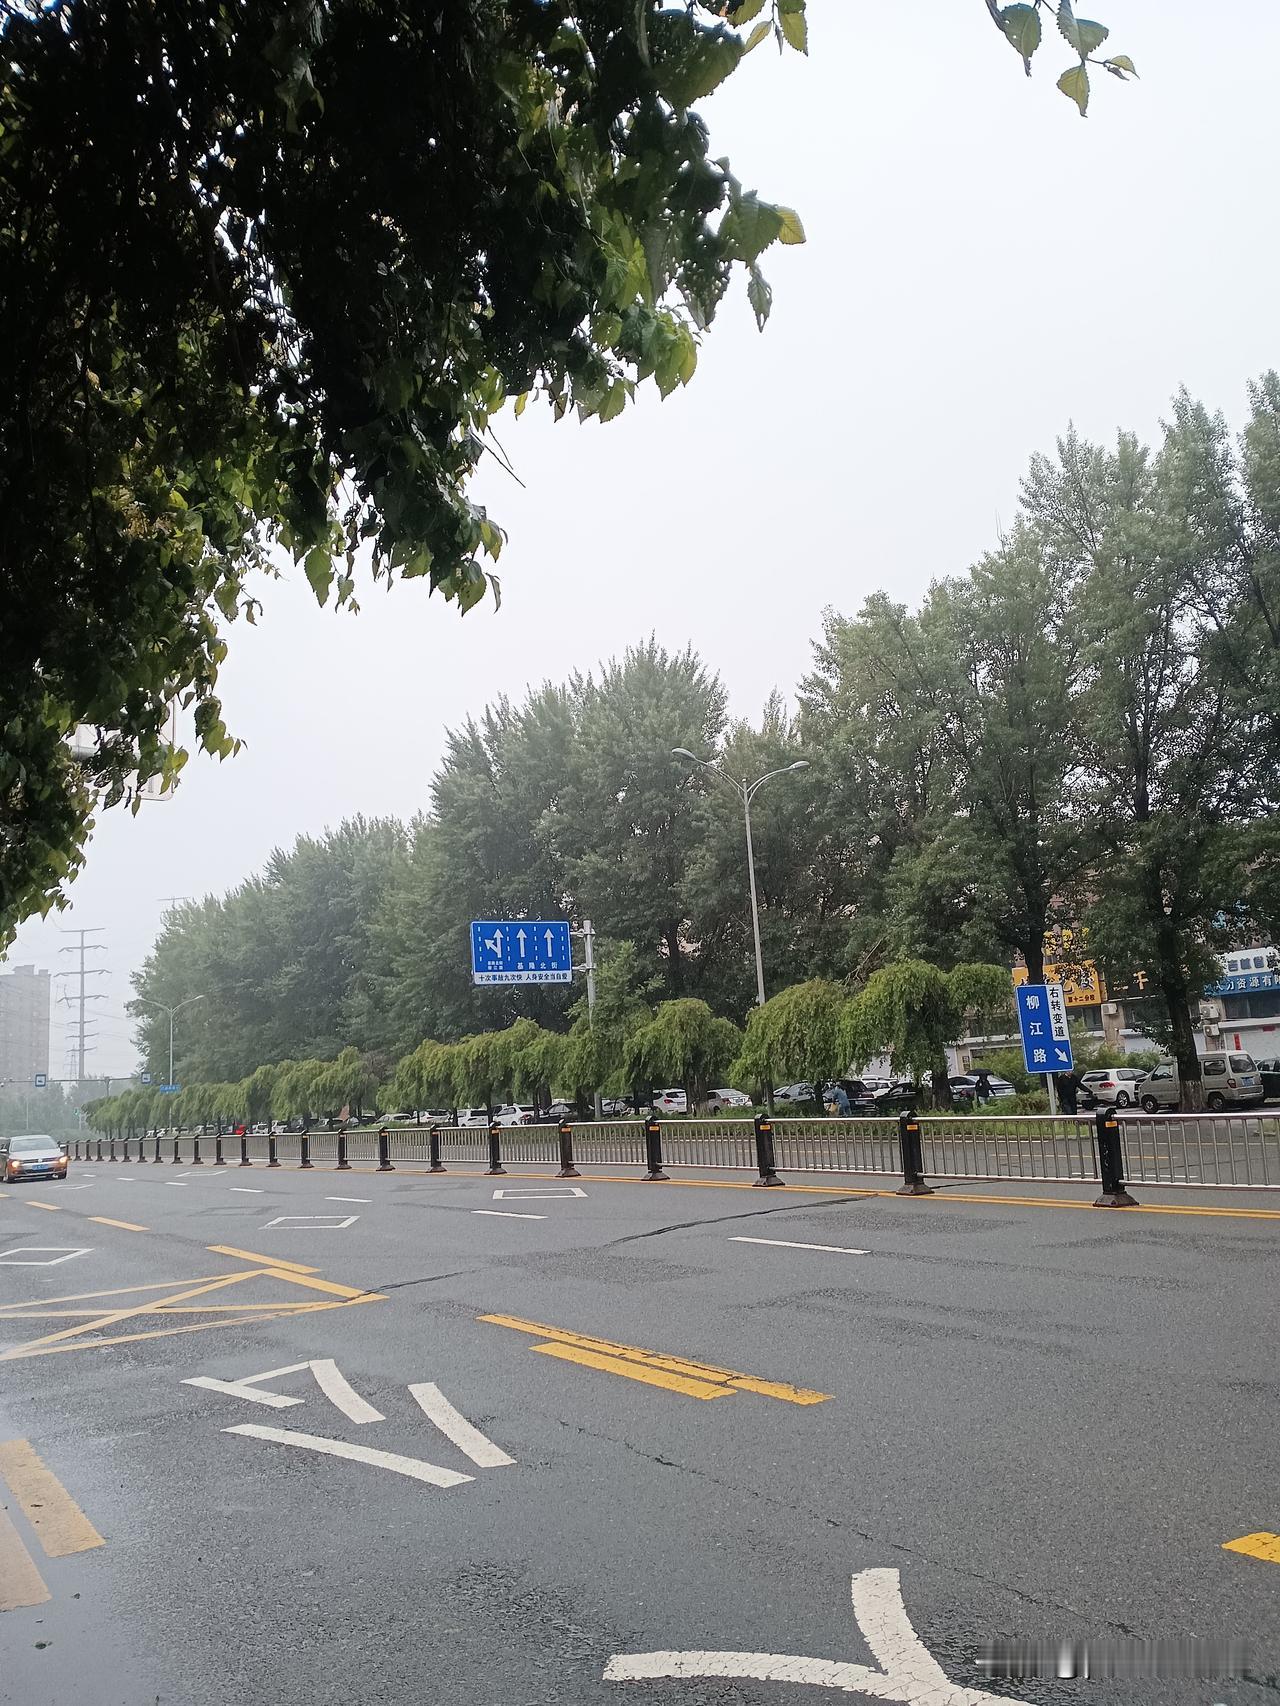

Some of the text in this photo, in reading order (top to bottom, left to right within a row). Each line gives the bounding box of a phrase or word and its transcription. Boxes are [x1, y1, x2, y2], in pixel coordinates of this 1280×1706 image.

[1026, 995, 1047, 1063] 柳江路
[1049, 987, 1065, 1037] 右转变道
